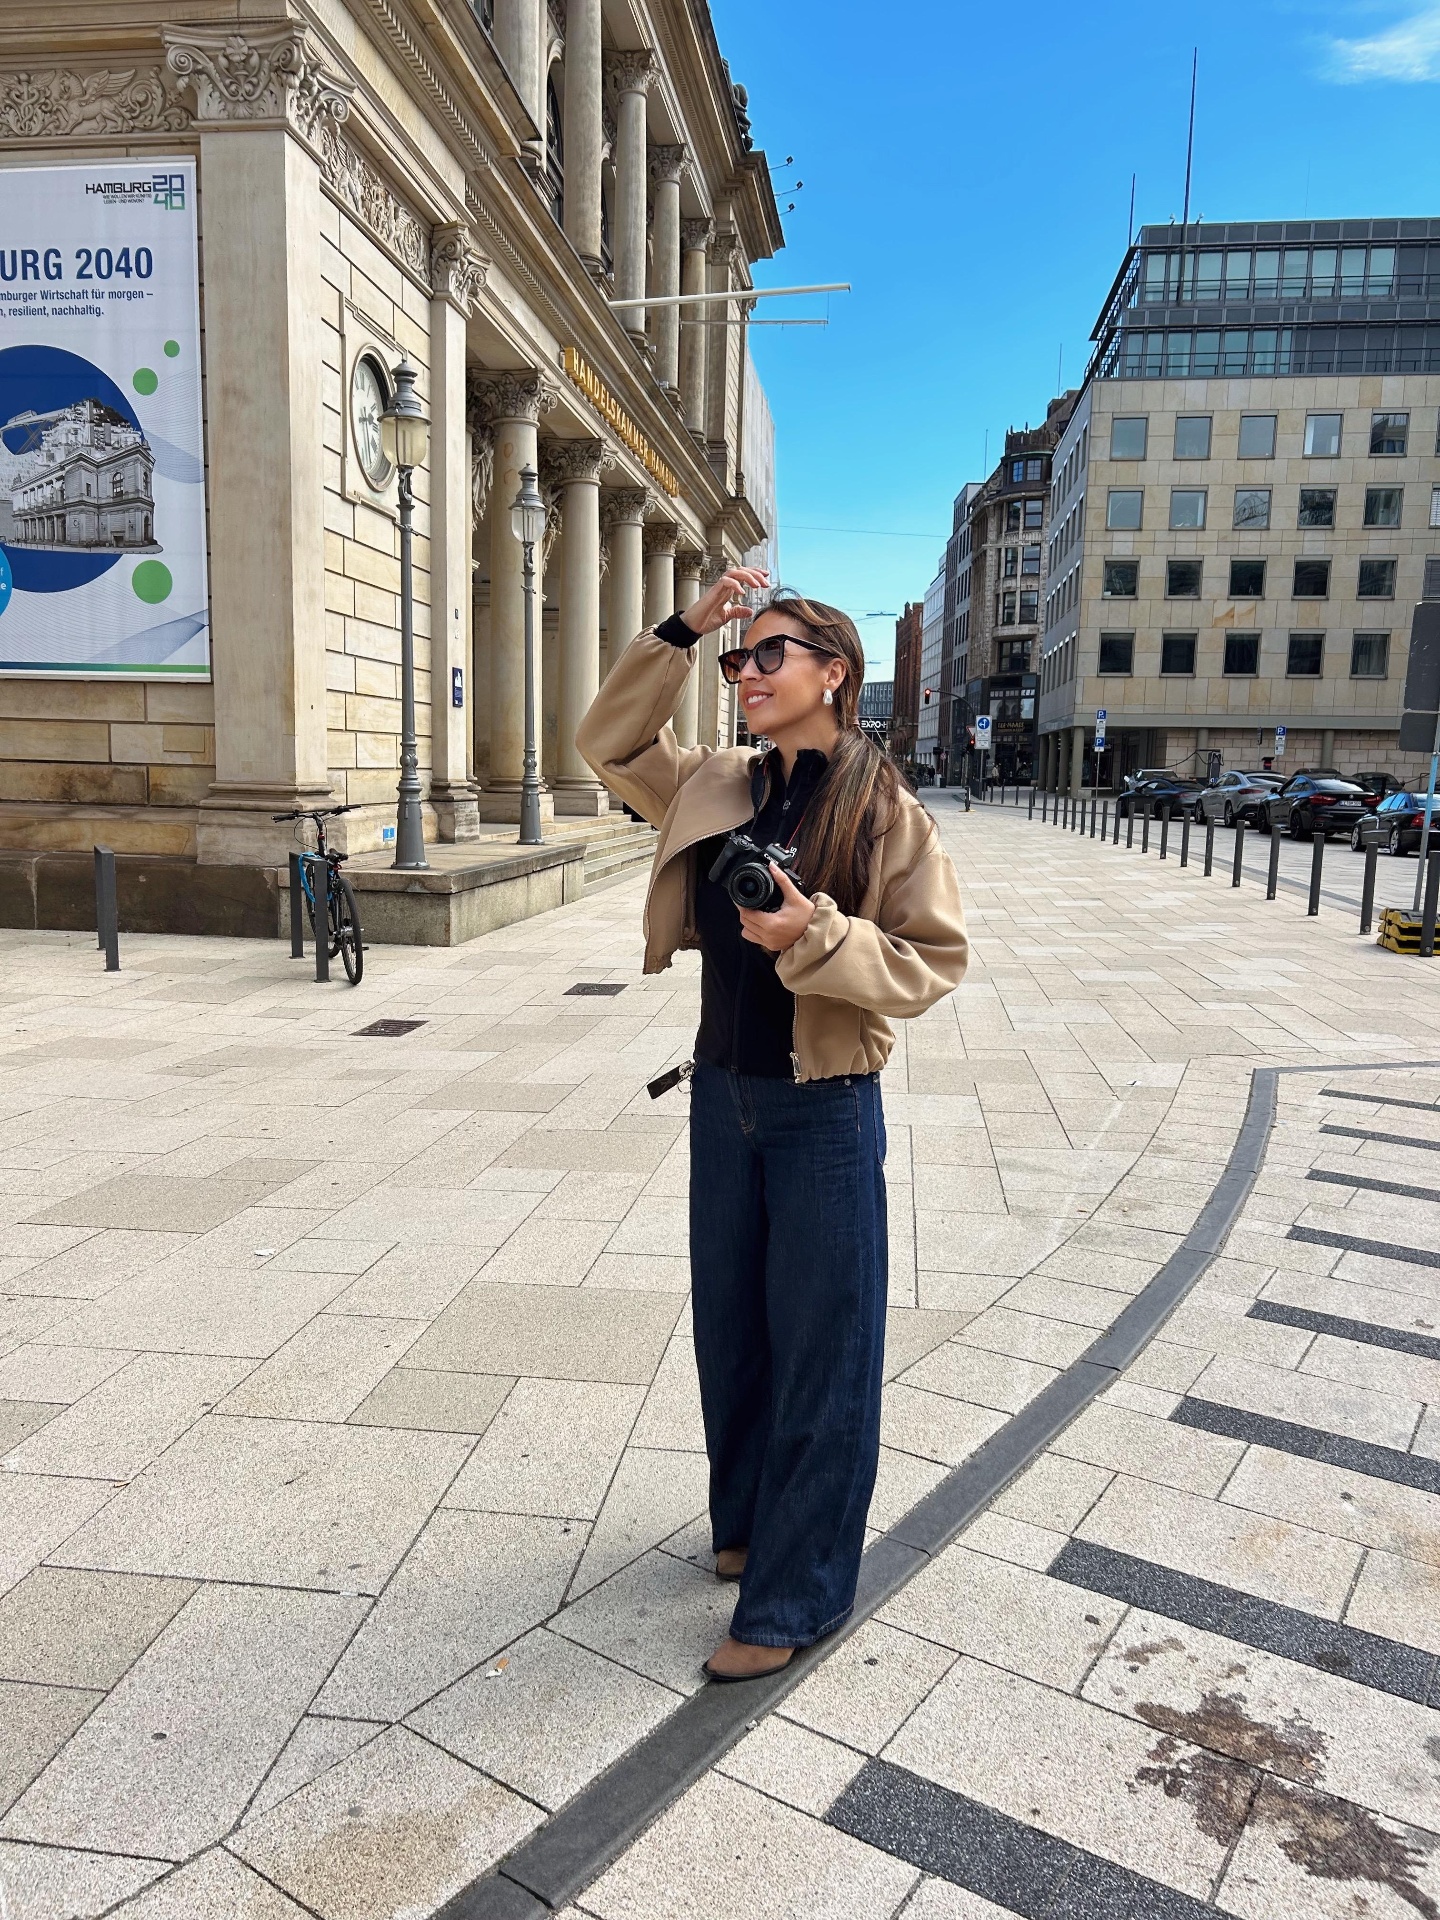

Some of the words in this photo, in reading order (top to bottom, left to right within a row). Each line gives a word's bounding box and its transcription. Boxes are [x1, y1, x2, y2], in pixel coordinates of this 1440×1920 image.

[85, 182, 151, 194] HAMBURG
[0, 249, 62, 281] URG
[75, 247, 153, 279] 2040
[40, 289, 89, 300] Wirtschaft
[91, 289, 105, 299] für
[108, 290, 144, 301] morgen
[8, 306, 49, 318] resilient,
[51, 305, 104, 317] nachhaltig.
[565, 347, 649, 460] HANDELSKAMMER
